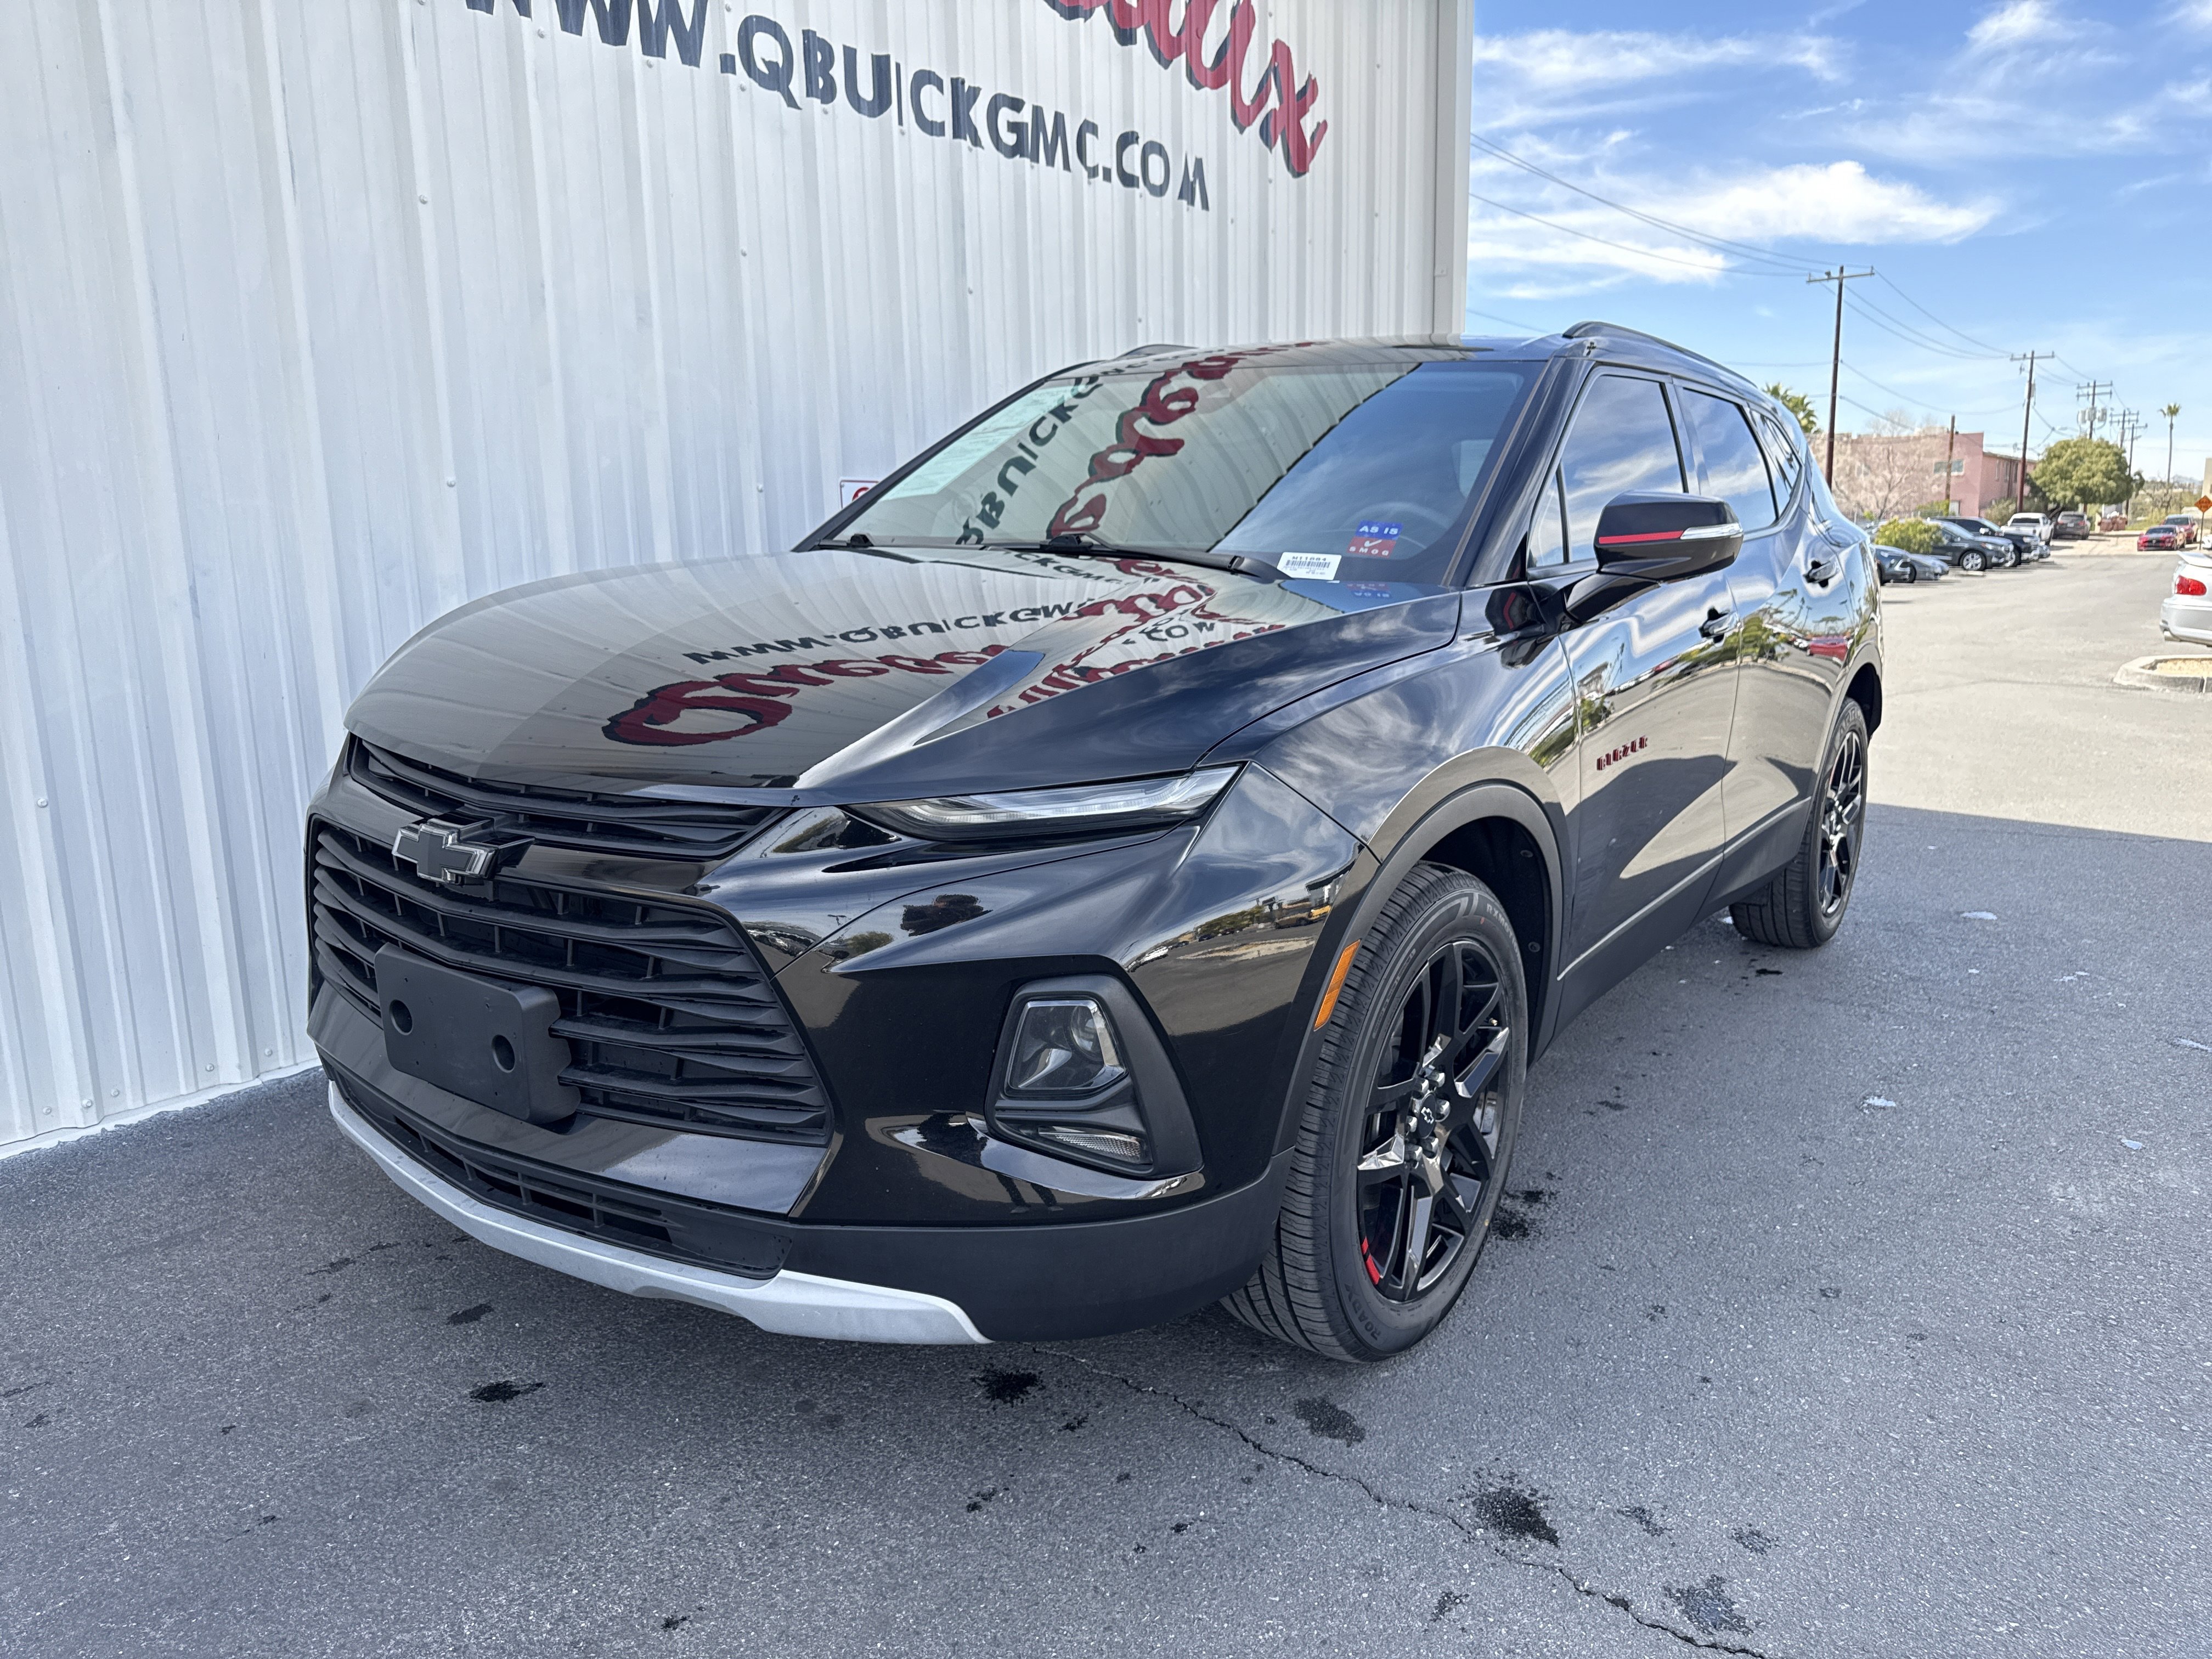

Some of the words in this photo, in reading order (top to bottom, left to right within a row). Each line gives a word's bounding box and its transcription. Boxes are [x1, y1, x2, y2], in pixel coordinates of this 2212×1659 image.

[465, 0, 1209, 211] WW.QBUICKGMC.COM
[1349, 546, 1389, 556] SMOG
[1344, 1283, 1381, 1341] ROADX
